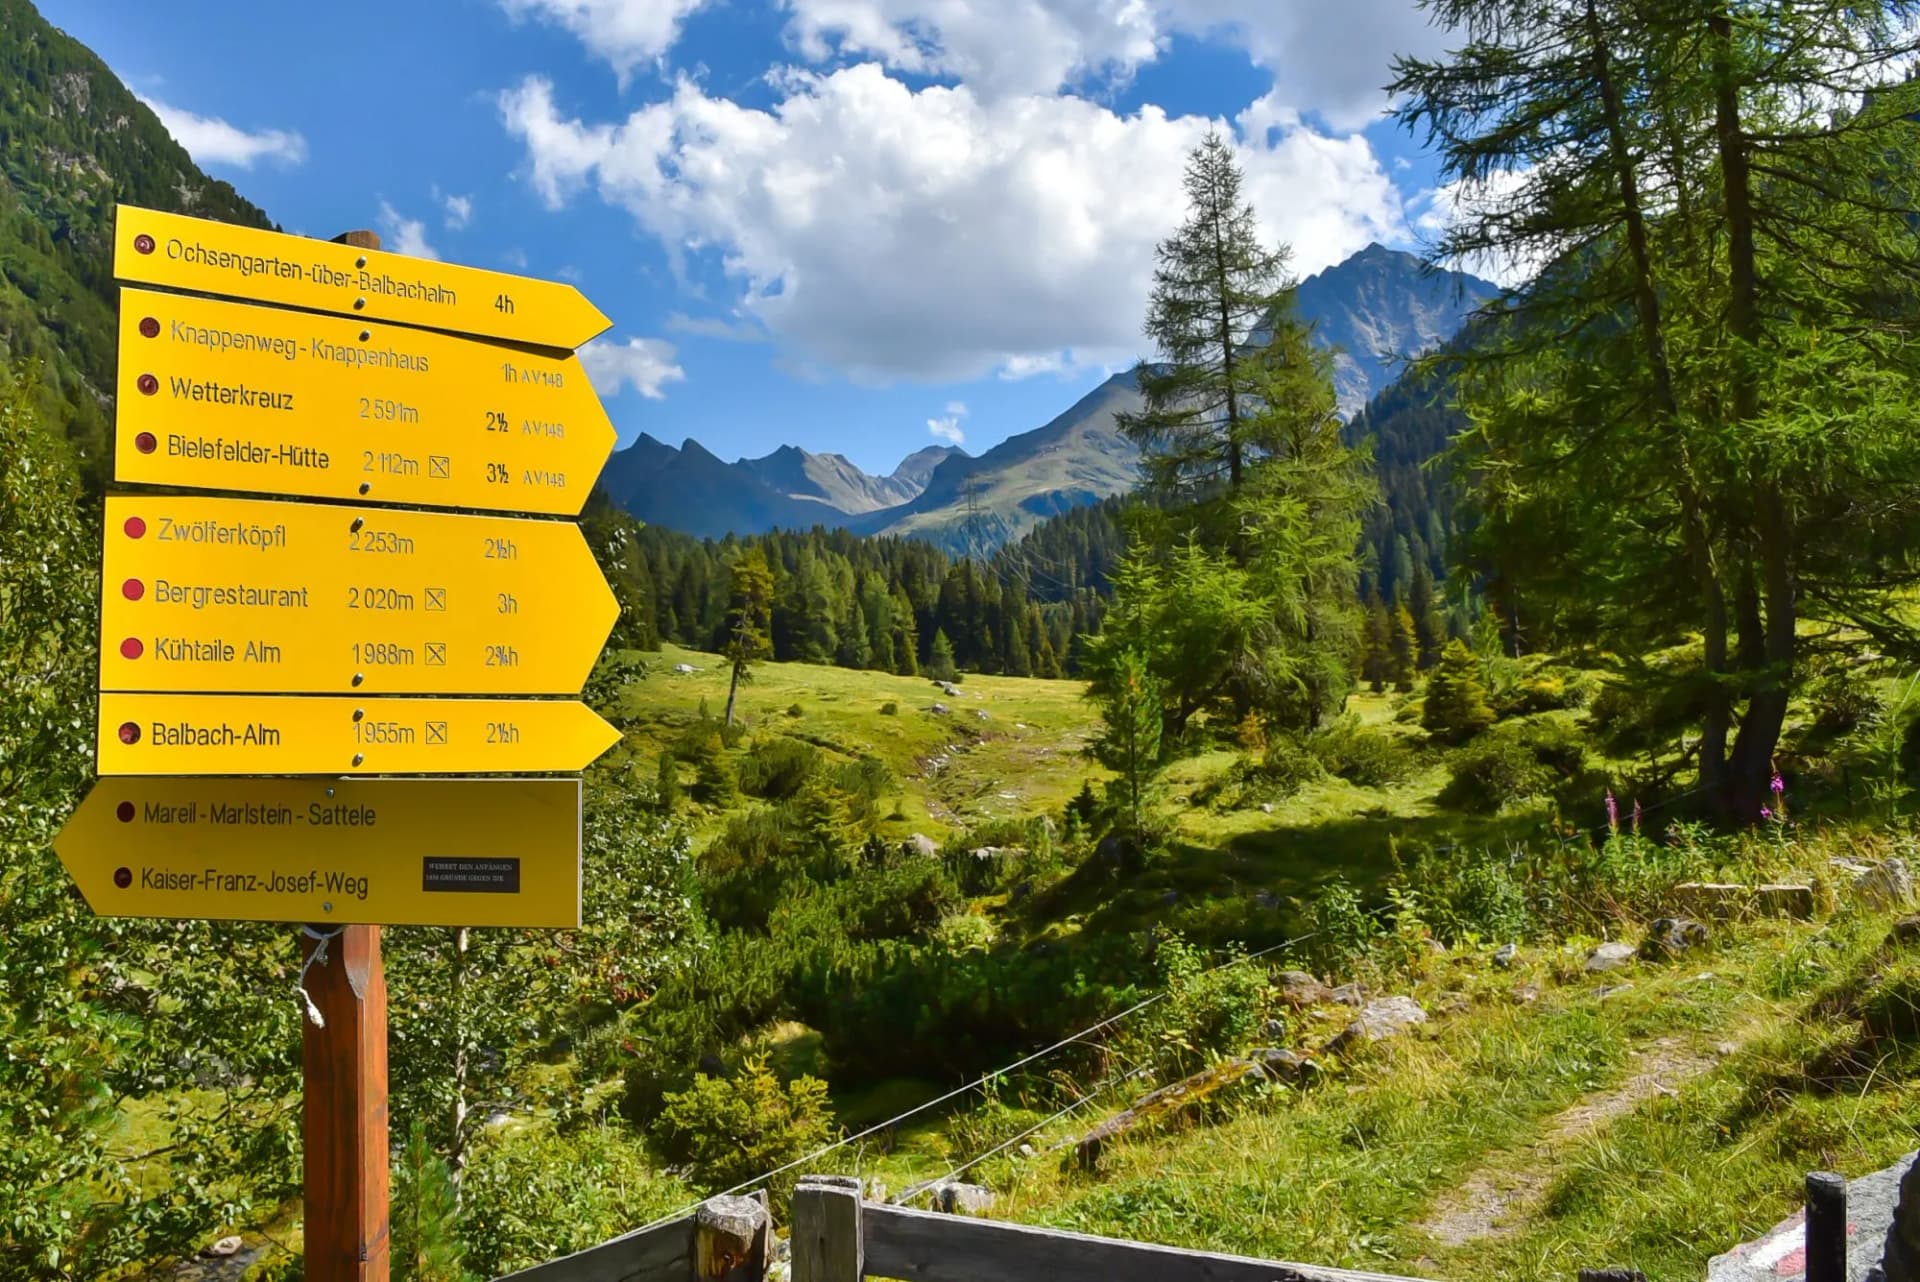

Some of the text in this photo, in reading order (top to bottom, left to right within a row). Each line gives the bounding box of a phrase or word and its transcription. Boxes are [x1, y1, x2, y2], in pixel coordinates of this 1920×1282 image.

[167, 239, 514, 314] Ochsengarten-über-Balbachalm 4h
[171, 320, 296, 361] Knappenweg
[312, 338, 429, 372] Knappenhaus
[502, 363, 517, 383] 1h
[170, 375, 293, 410] Wetterkreuz
[168, 434, 329, 469] Bielefelder-Hütte
[158, 518, 286, 551] Zwölferköpfl
[155, 580, 308, 609] Bergrestaurant
[497, 593, 517, 614] 3h
[155, 637, 235, 662] Kühtaile
[244, 640, 281, 663] Alm
[152, 722, 280, 746] Balbach-Alm
[144, 802, 196, 825] Mareil
[210, 803, 293, 826] Marlstein
[308, 803, 377, 827] Sattele
[141, 867, 369, 900] Kaiser-Franz-Josef-Weg
